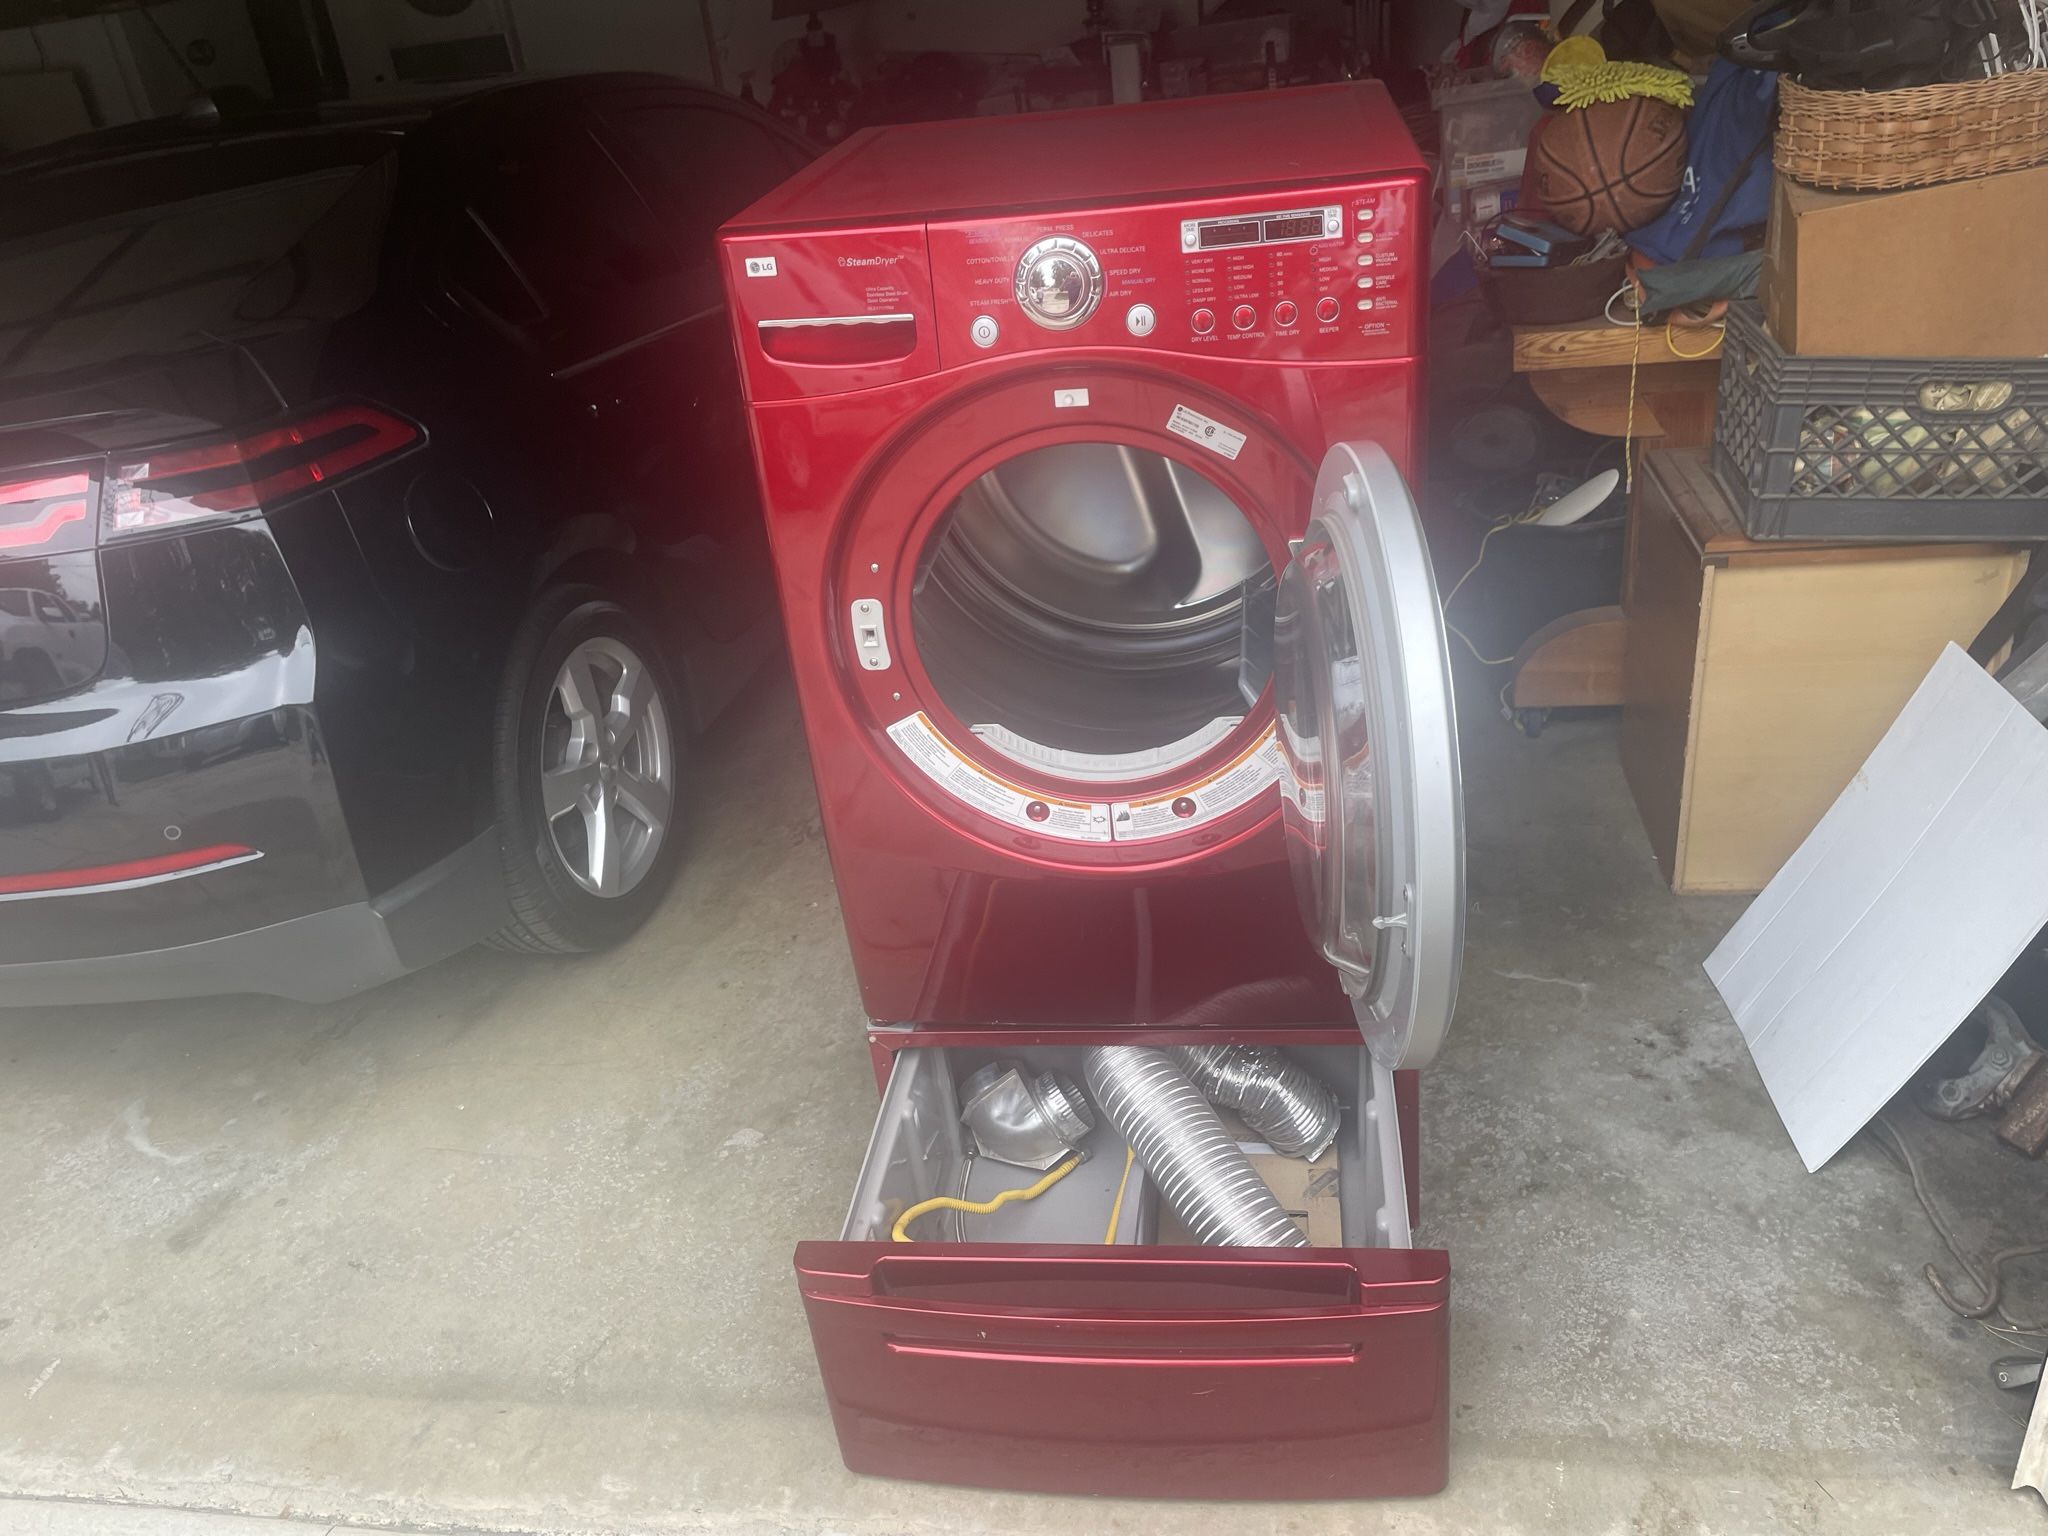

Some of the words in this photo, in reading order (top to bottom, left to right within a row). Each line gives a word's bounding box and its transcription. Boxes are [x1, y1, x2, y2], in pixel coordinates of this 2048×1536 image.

[1082, 230, 1114, 238] DELICATES
[1100, 247, 1118, 255] ULTRA
[762, 263, 773, 271] LG
[1319, 326, 1339, 334] BEEPER
[1364, 322, 1385, 330] OPTION
